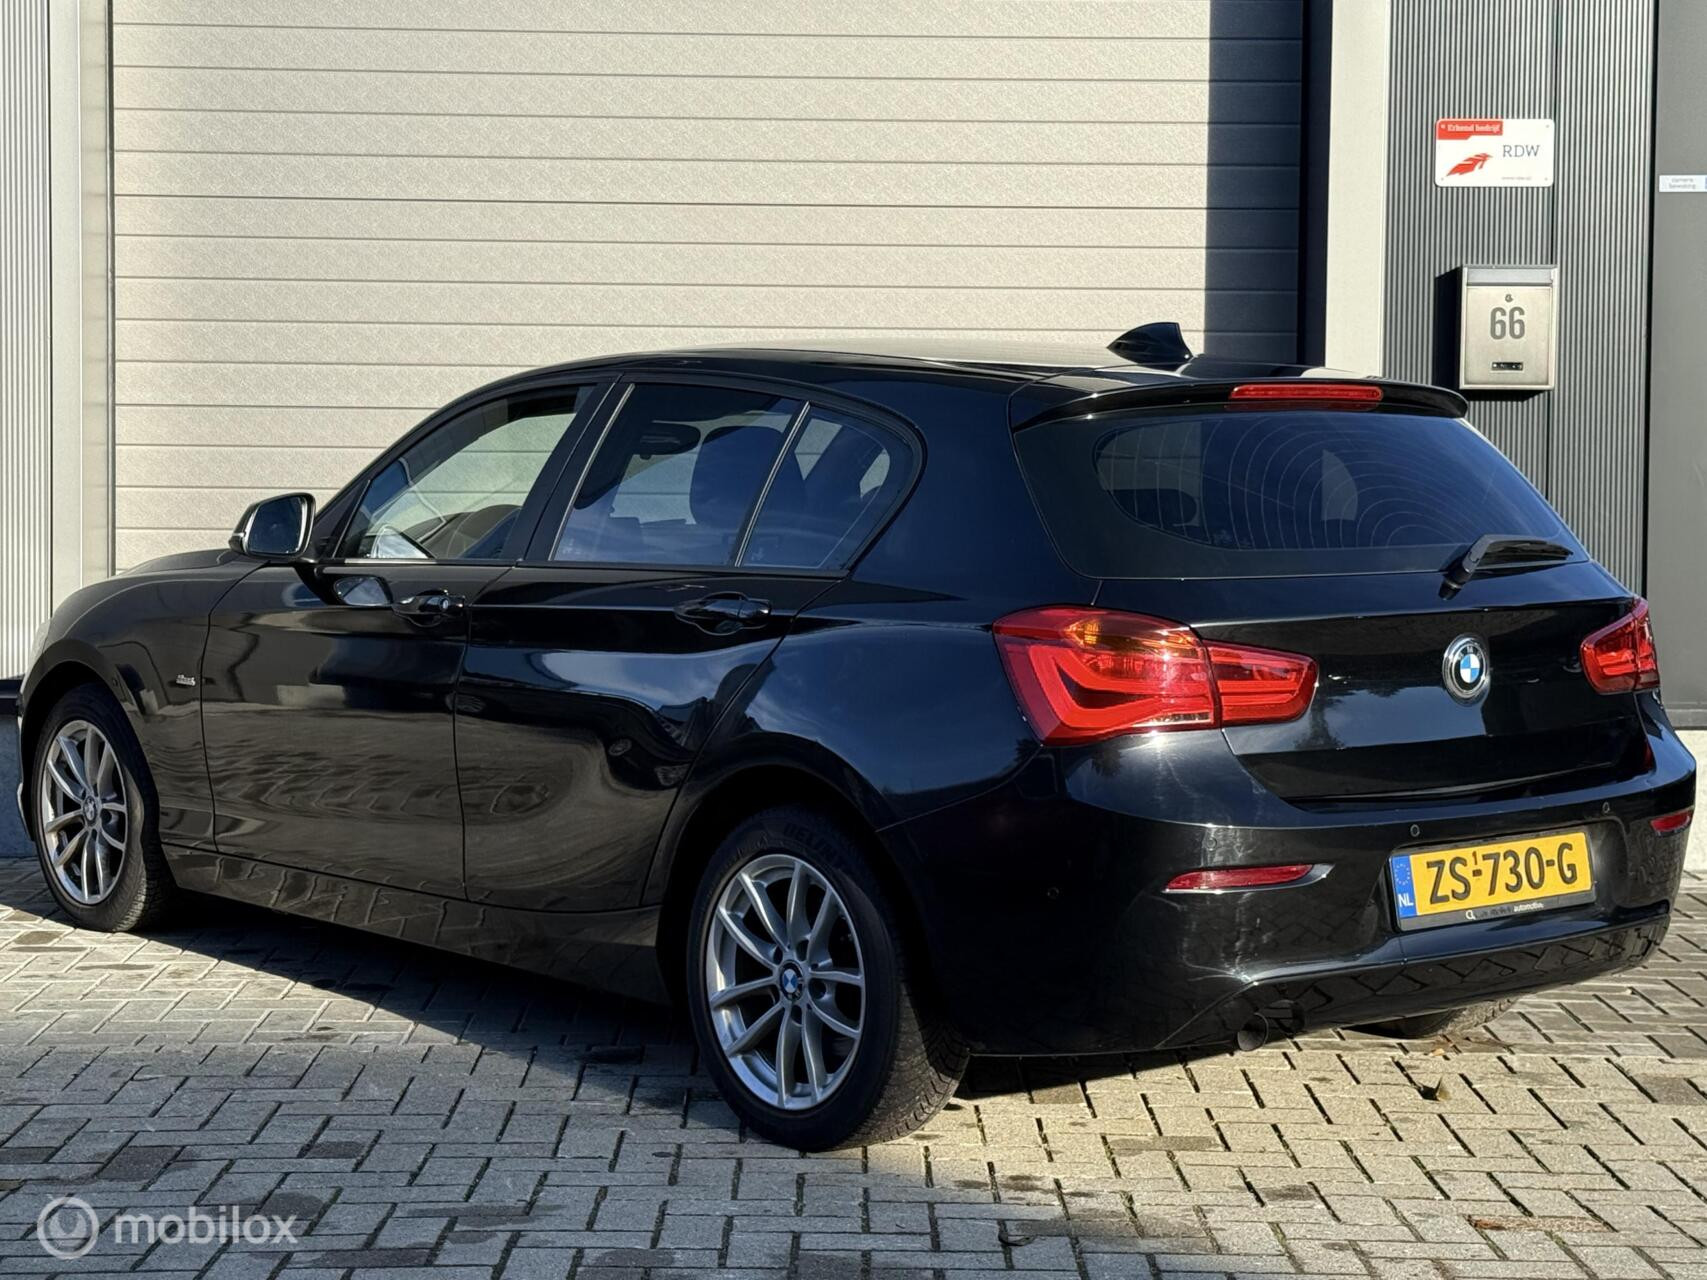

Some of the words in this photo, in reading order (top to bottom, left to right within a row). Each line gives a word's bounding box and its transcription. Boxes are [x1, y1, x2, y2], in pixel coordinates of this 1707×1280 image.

[1502, 144, 1541, 158] RDW
[1490, 306, 1526, 341] 66
[1426, 842, 1578, 905] ZS-730-G
[1398, 893, 1414, 908] NL
